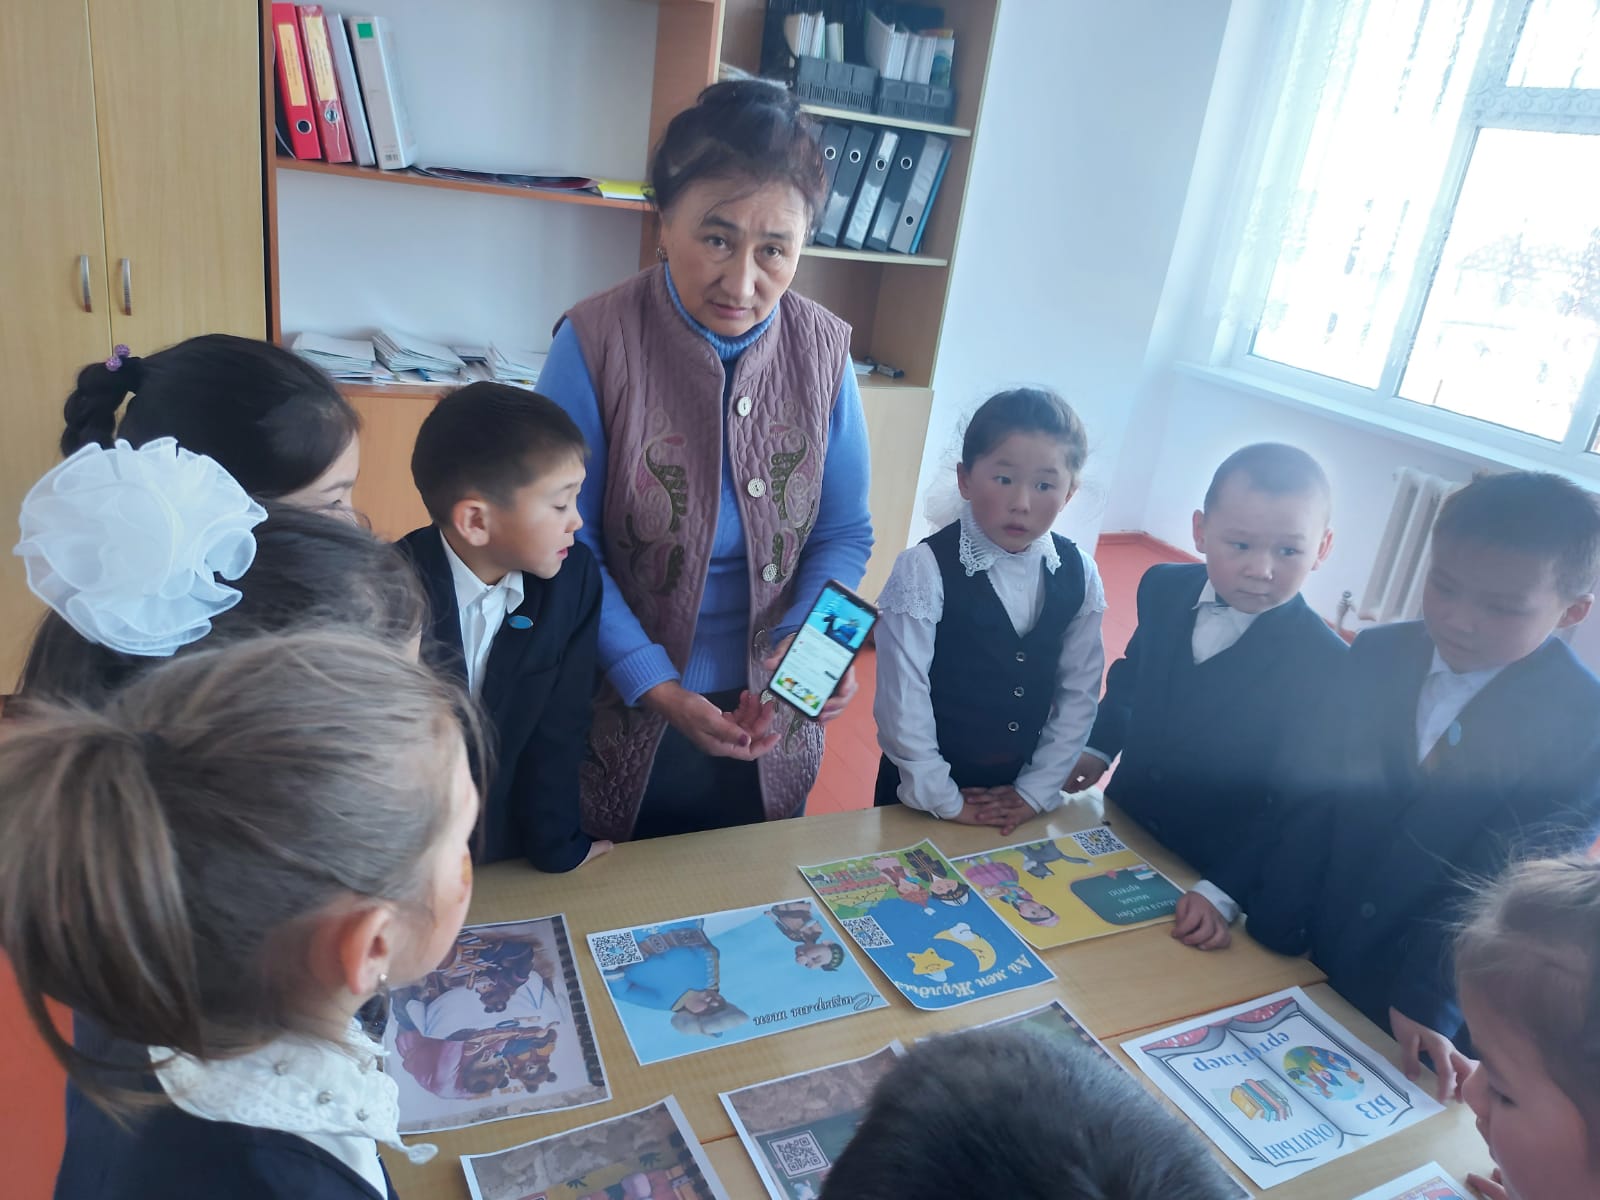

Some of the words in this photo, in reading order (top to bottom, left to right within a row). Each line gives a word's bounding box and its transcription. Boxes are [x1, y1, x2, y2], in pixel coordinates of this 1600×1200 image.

[1008, 954, 1032, 975] Ай
[975, 969, 1008, 988] мен
[1193, 1032, 1290, 1072] ертегілер
